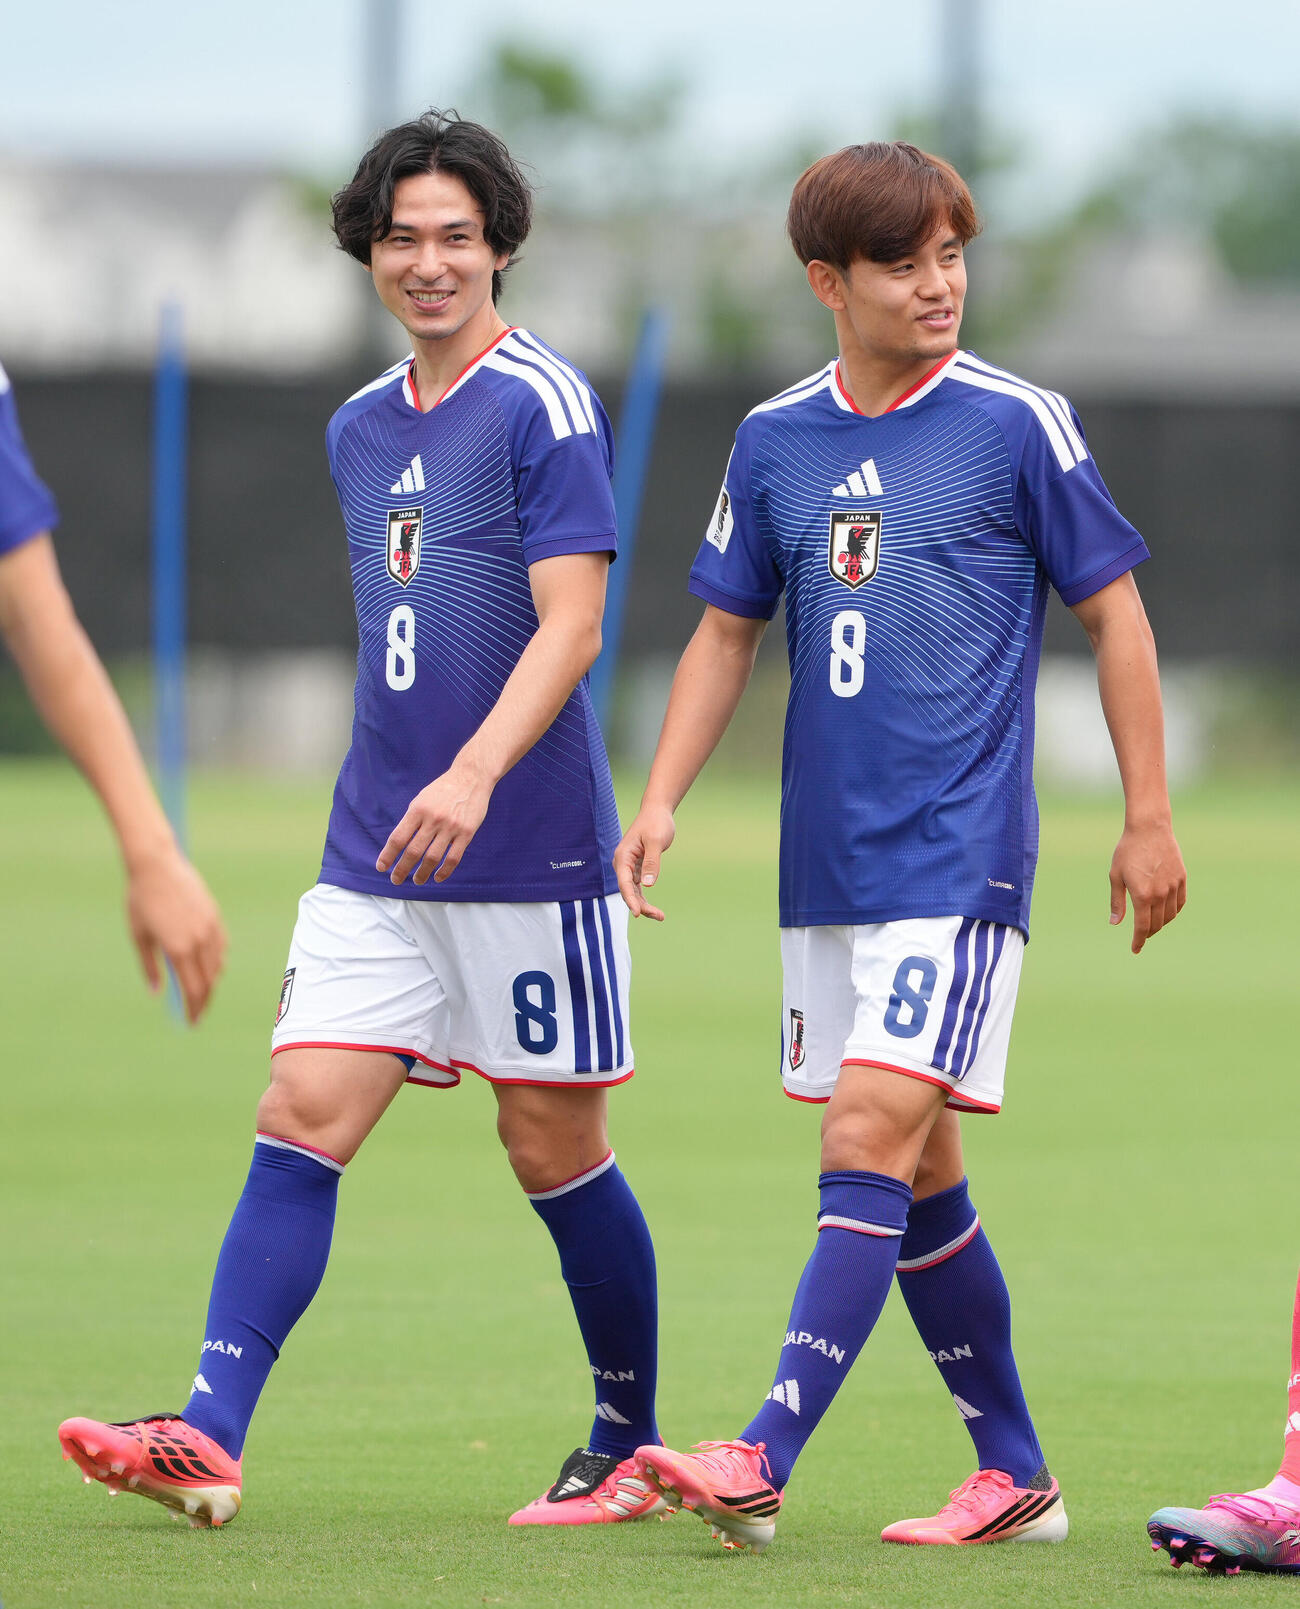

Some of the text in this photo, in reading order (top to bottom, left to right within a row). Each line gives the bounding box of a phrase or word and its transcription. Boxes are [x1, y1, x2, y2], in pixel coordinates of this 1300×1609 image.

[397, 511, 416, 519] JAPAN
[397, 561, 412, 573] JFA
[842, 564, 864, 576] JFA
[385, 604, 416, 691] 8
[829, 610, 866, 698] 8
[883, 955, 938, 1039] 8
[512, 970, 559, 1055] 8
[202, 1340, 243, 1359] PAN
[590, 1364, 635, 1381] PAN
